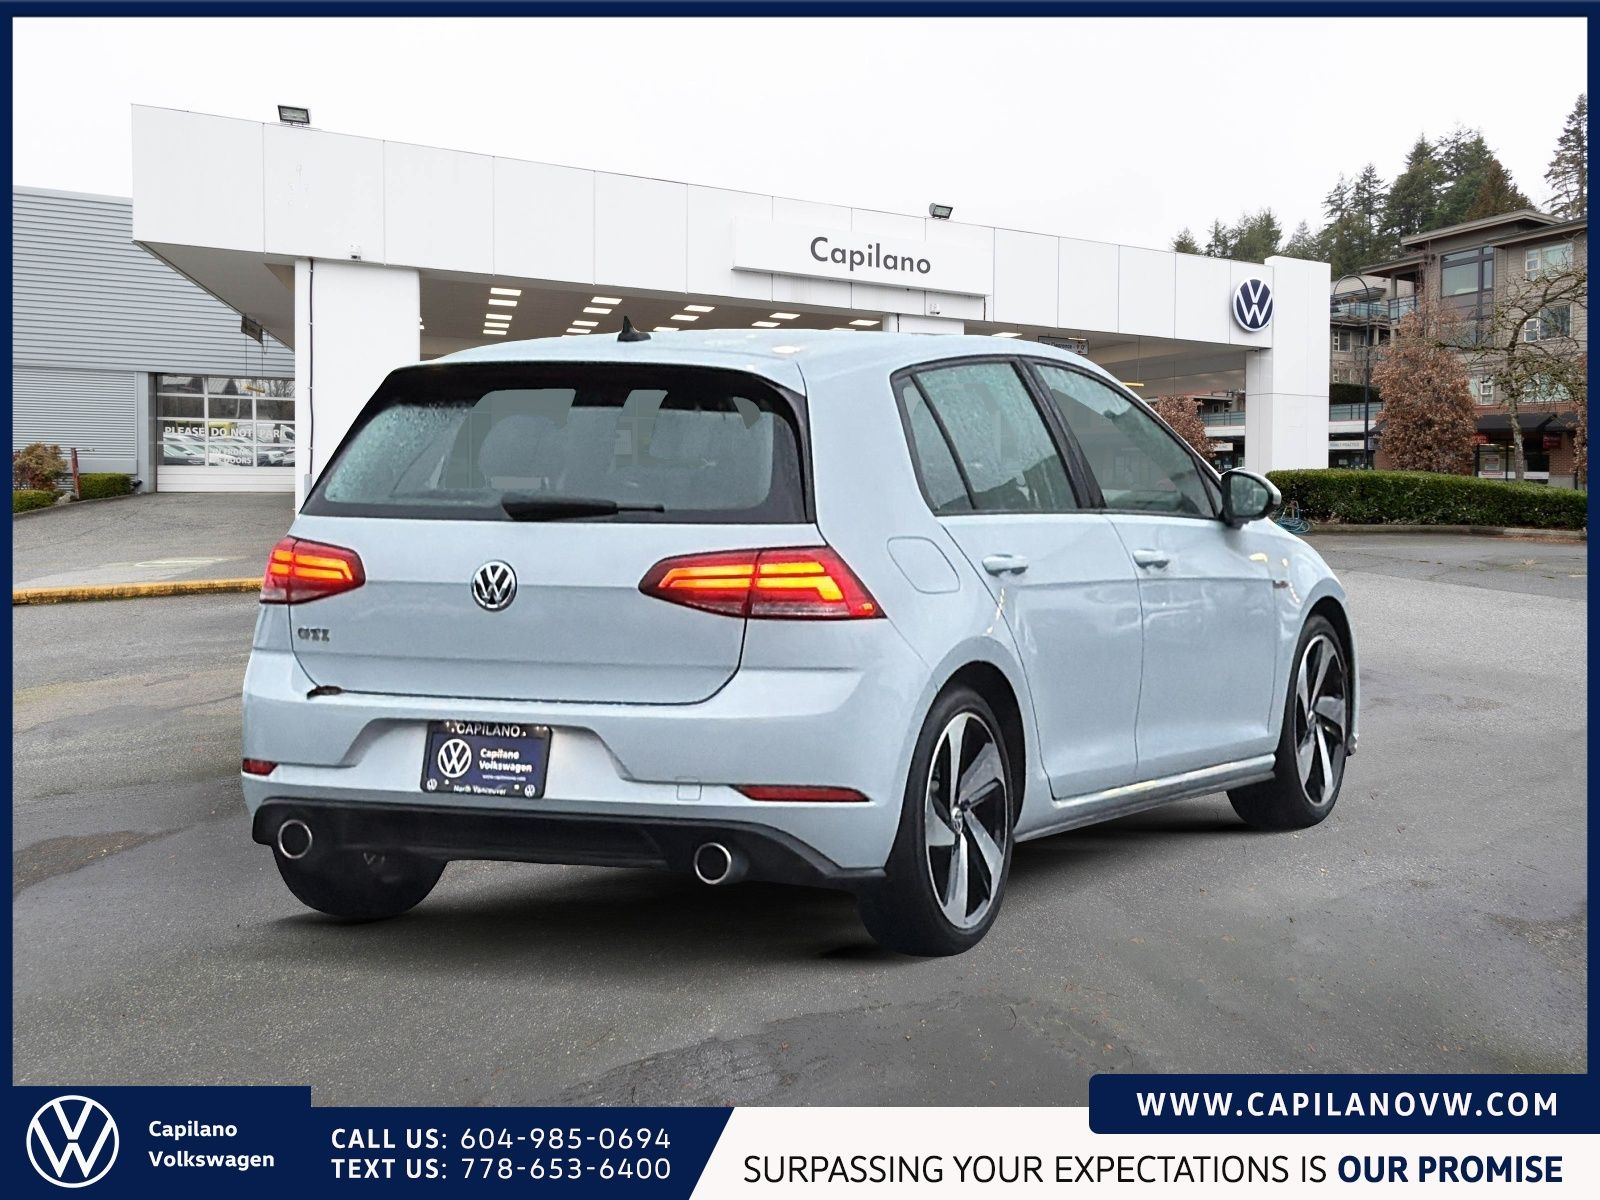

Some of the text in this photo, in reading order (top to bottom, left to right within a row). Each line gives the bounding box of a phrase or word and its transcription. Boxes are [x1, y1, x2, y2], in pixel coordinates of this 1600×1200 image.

[810, 236, 931, 274] Capilano
[164, 426, 205, 437] PLEASE
[210, 427, 227, 437] DO
[230, 427, 253, 438] NOT
[298, 628, 330, 642] GTI
[456, 723, 521, 738] CAPILANO
[480, 748, 520, 761] Capilano
[479, 760, 533, 773] Volkswagen
